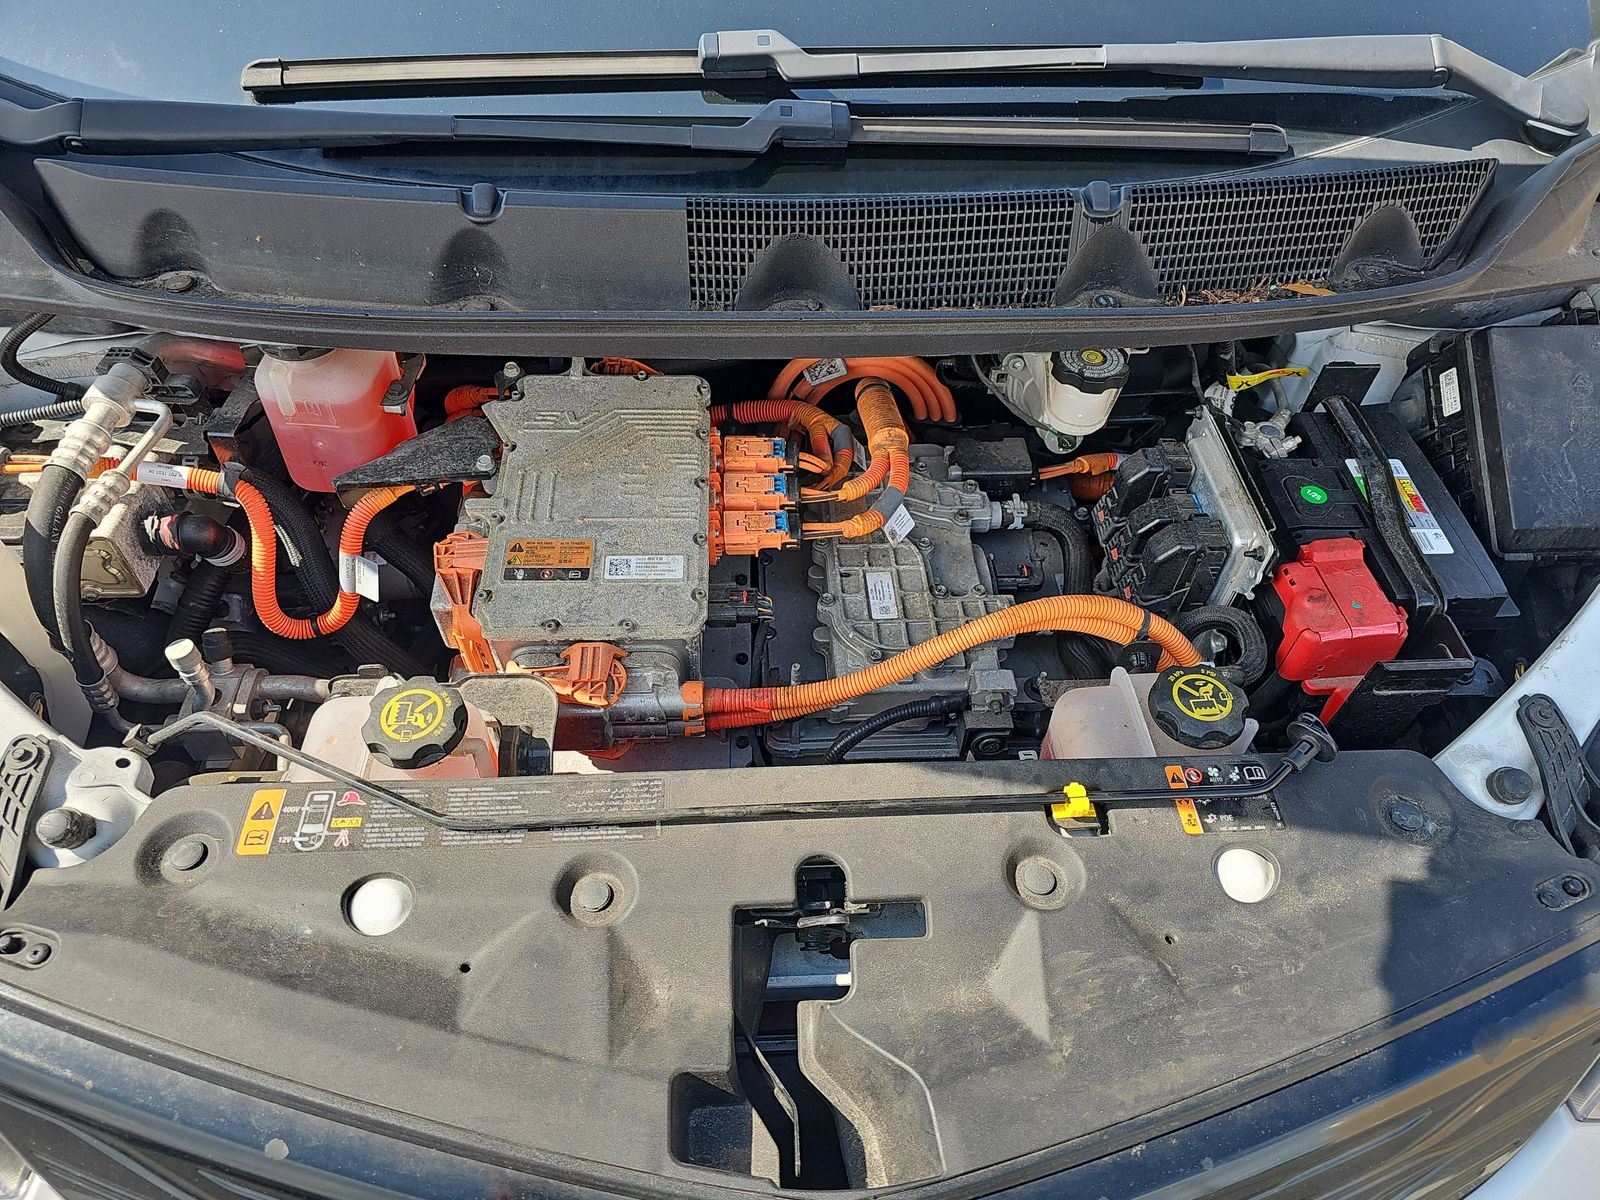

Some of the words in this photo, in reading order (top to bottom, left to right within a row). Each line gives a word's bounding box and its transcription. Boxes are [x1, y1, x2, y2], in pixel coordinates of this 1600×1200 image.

[1306, 489, 1322, 501] 1/25
[50, 505, 64, 544] GALAXY
[1205, 670, 1217, 678] PSI
